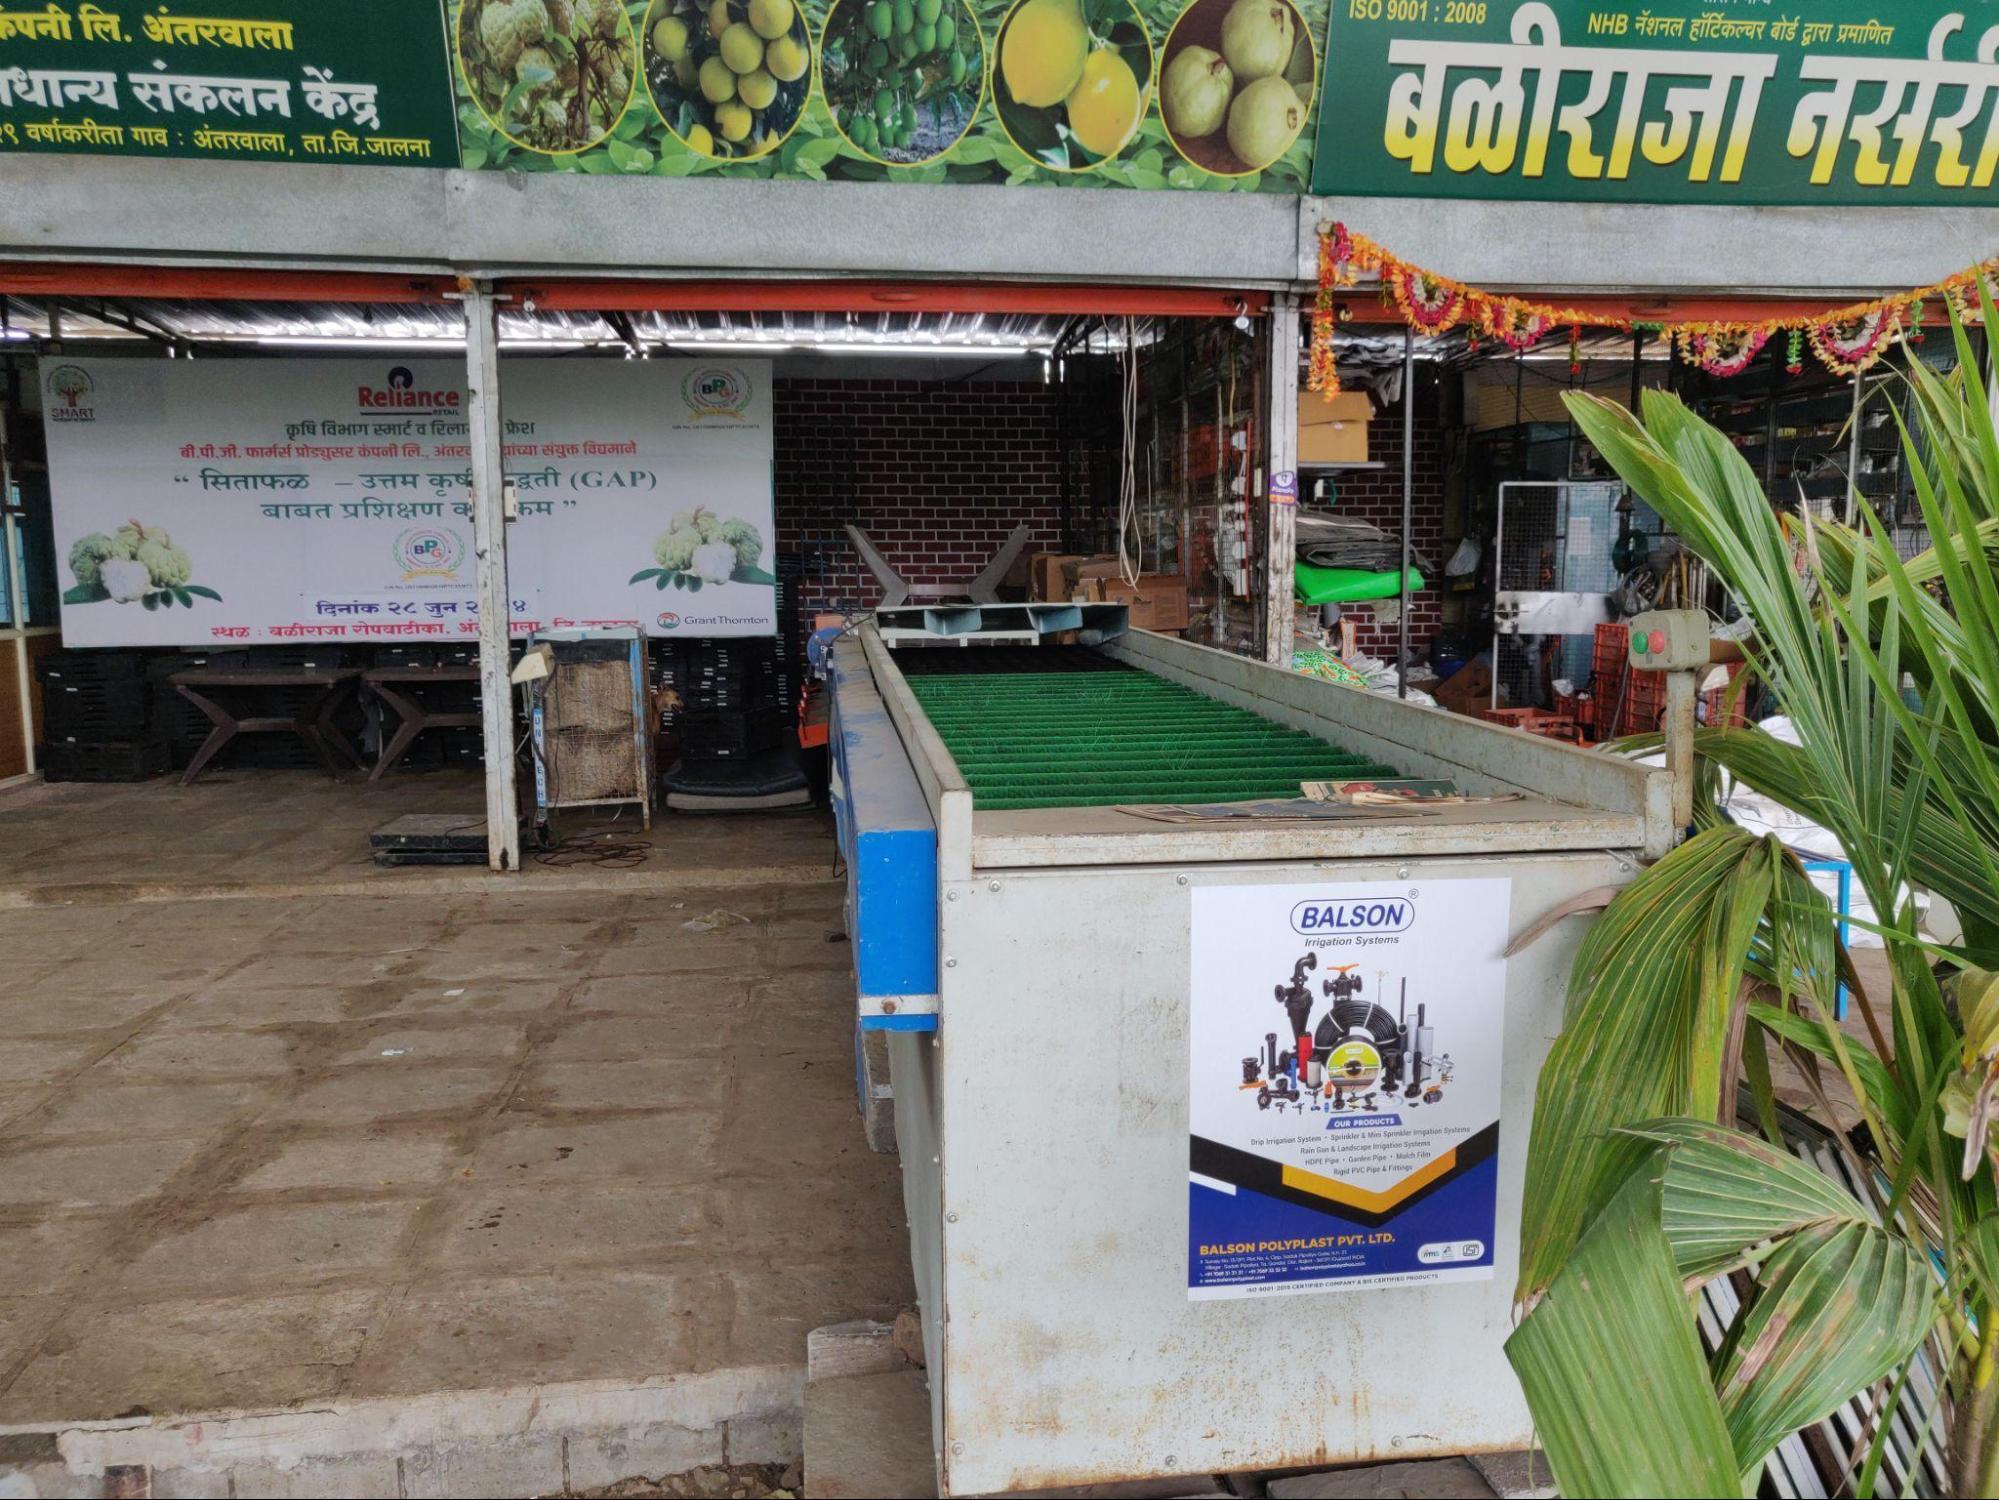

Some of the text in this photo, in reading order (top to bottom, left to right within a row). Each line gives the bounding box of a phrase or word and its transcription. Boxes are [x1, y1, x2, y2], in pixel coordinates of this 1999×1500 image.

[1349, 0, 1382, 19] ISO
[1387, 0, 1428, 21] 9001
[1444, 2, 1488, 24] 2008
[78, 3, 133, 42] लि.
[142, 5, 293, 50] अंतरवाला
[1588, 12, 1628, 36] NHB
[1769, 14, 1801, 42] बोर्ड
[1836, 18, 1895, 45] प्रमाणित
[127, 59, 291, 118] संकलन
[301, 65, 381, 131] केंद्र
[1383, 2, 1779, 183] बळीराजा
[25, 118, 124, 145] वर्षाकरीता
[130, 126, 168, 148] गाव
[357, 384, 460, 408] Reliance
[51, 407, 95, 418] SMART
[285, 421, 317, 441] कृषि
[321, 421, 371, 437] विभाग
[373, 420, 413, 437] स्मार्ट
[416, 424, 427, 437] व
[358, 444, 398, 458] कंपनी
[199, 467, 310, 492] सिताफळ
[360, 472, 422, 491] उत्तम
[570, 470, 657, 492] (GAP)
[260, 502, 333, 520] बाबत
[340, 497, 444, 521] प्रशिक्षण
[315, 600, 380, 617] दिनांक
[387, 601, 417, 615] २८
[465, 600, 527, 615] २४
[684, 615, 769, 625] Grant Thornton
[1301, 904, 1405, 929] BALSON
[1304, 935, 1400, 949] Irrigation Systems
[1333, 1117, 1396, 1128] OUR PRODUCTS
[1250, 1138, 1265, 1147] Drip
[1266, 1135, 1296, 1146] Irrigation
[1297, 1134, 1322, 1144] System
[1200, 1233, 1396, 1256] BALSON POLYPLAST PVT. LTD.
